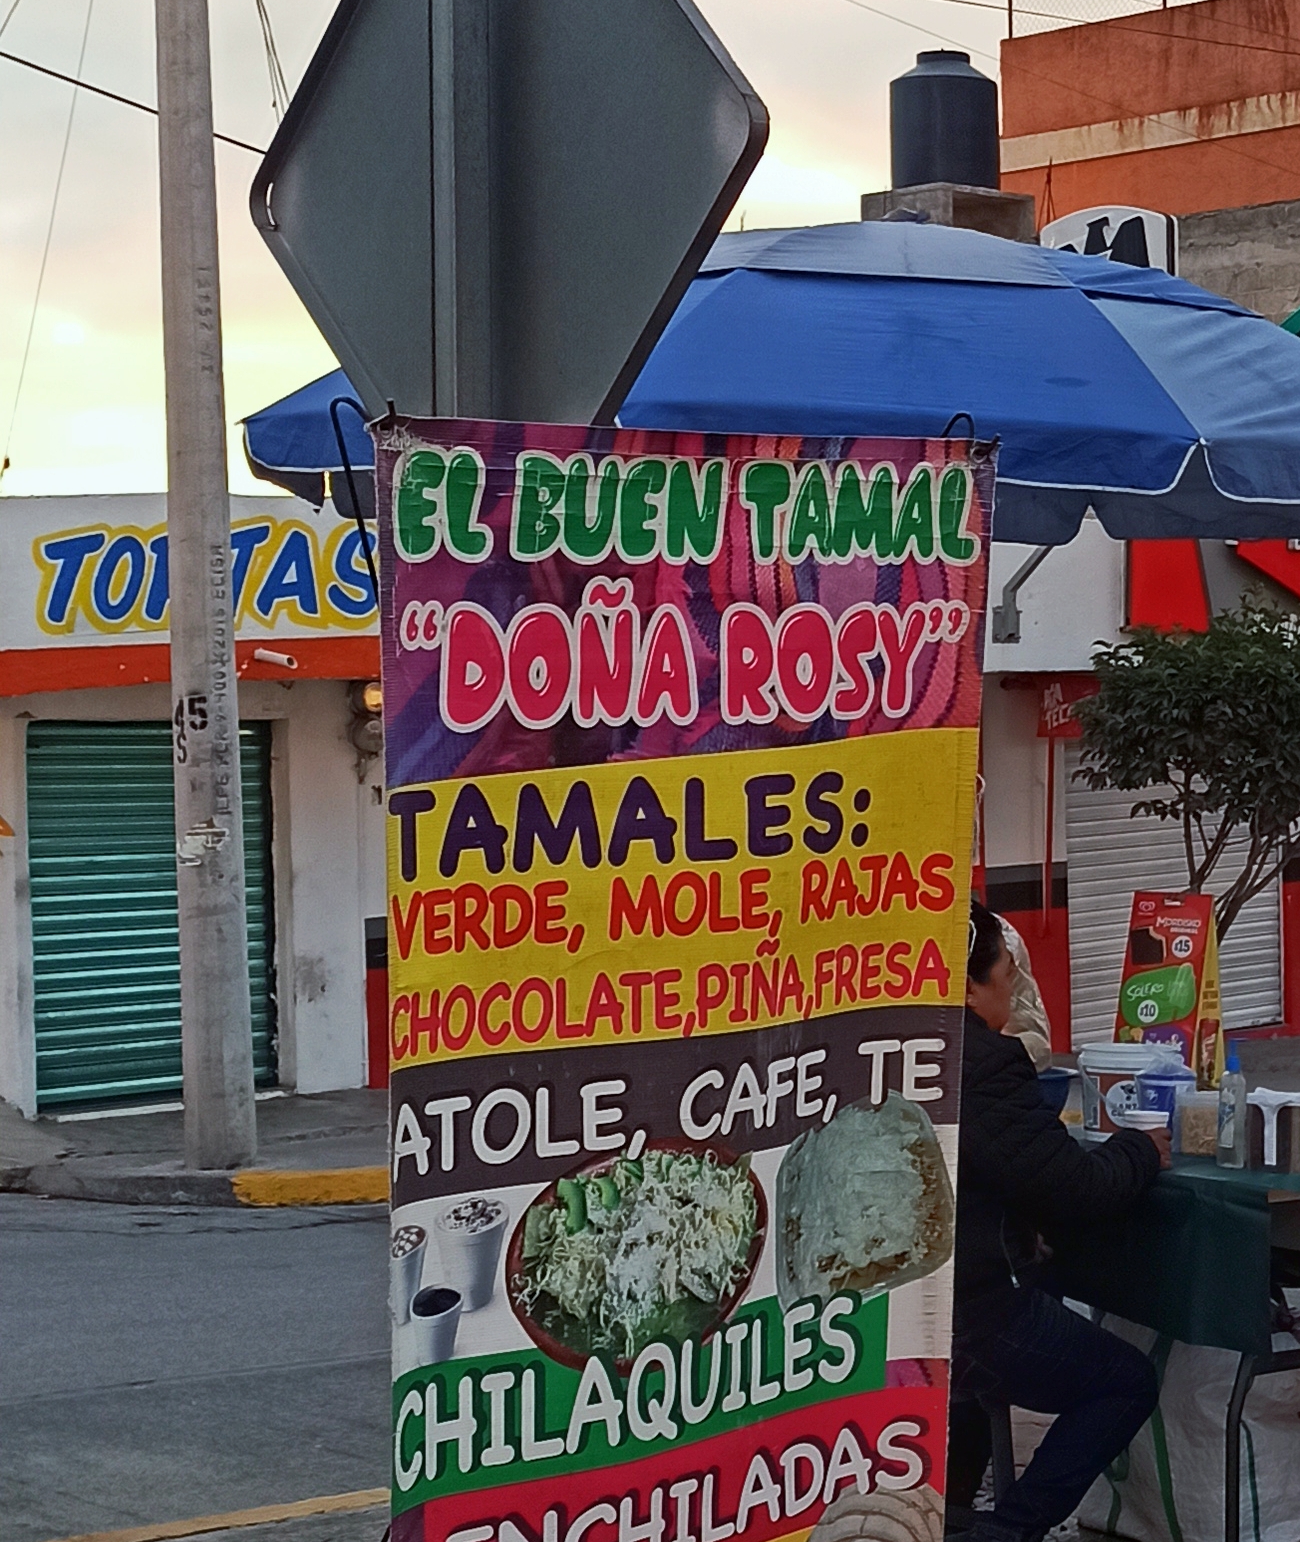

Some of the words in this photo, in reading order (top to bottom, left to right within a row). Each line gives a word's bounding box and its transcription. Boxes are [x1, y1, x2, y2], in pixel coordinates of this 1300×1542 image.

[395, 448, 491, 561] EL
[512, 451, 728, 563] BUEN
[741, 461, 979, 564] TAMAL
[389, 771, 871, 882] TAMALES:
[391, 879, 586, 960] VERDE,
[608, 869, 783, 941] MOLE,
[800, 850, 955, 925] RAJAS
[393, 1079, 647, 1183] ATOLE,
[679, 1049, 837, 1140] CAFE,
[857, 1038, 946, 1105] TE
[393, 1296, 857, 1492] CHILAQUILES
